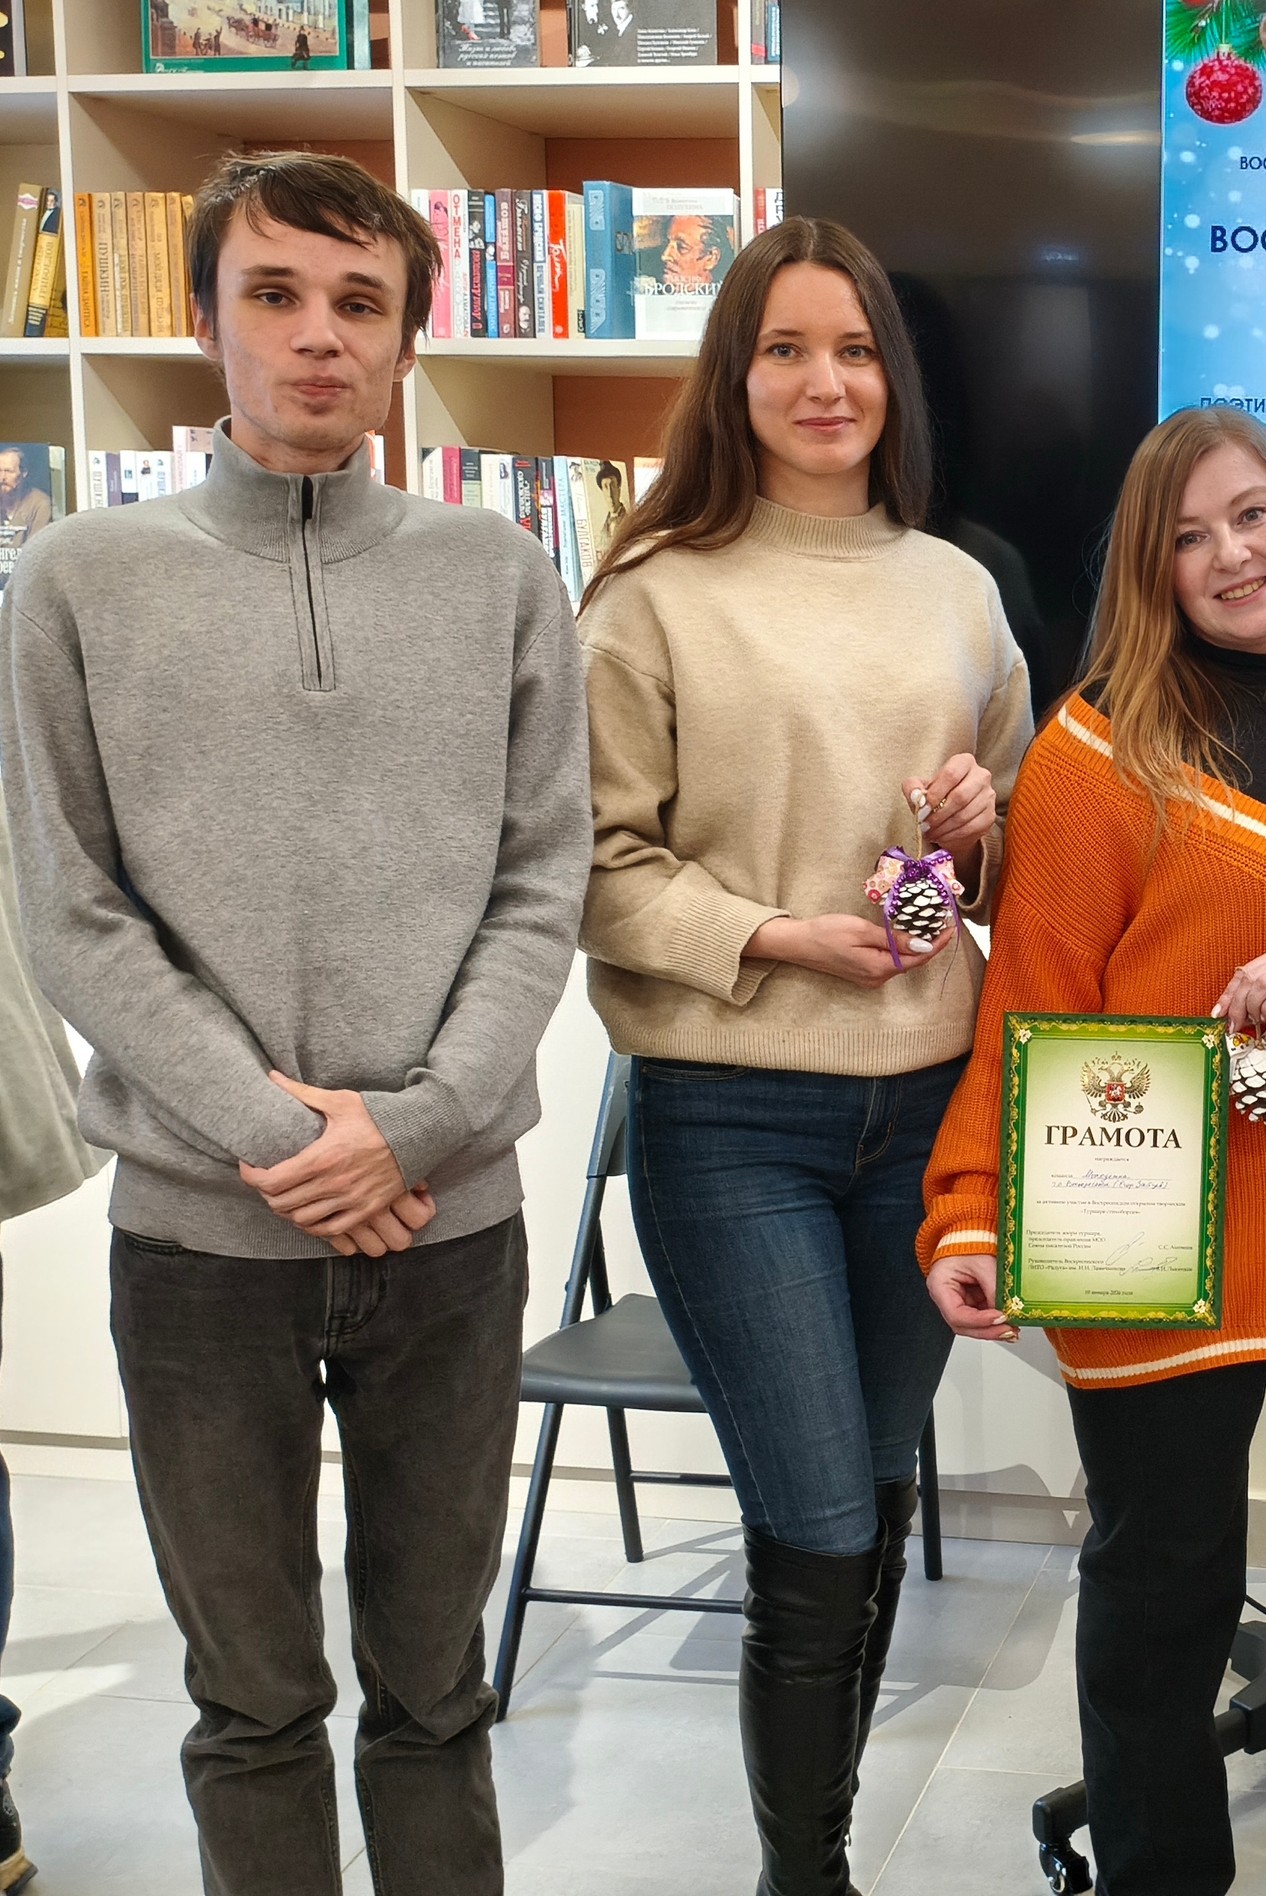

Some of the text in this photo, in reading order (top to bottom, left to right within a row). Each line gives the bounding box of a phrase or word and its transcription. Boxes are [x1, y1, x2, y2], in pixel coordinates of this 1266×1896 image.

[453, 194, 461, 258] ОТМЕНА
[98, 242, 110, 294] ПУШКИН
[576, 518, 592, 568] БУЛГАКОВ
[1045, 1125, 1182, 1149] ГРАМОТА
